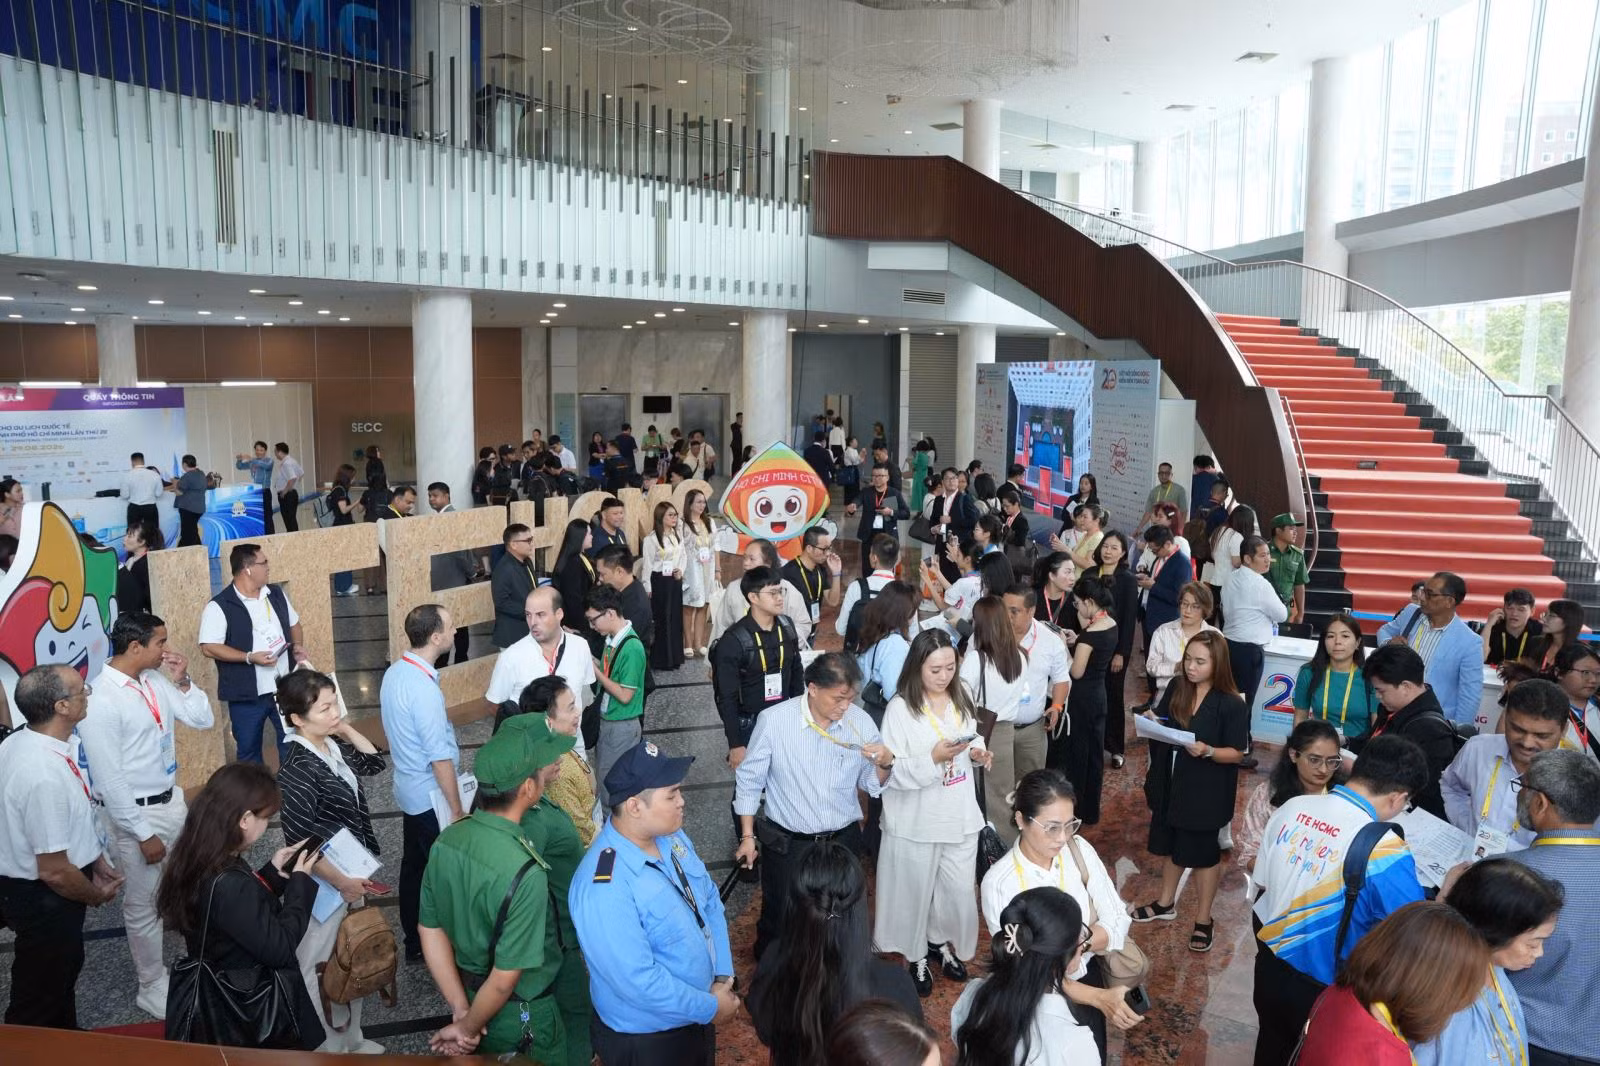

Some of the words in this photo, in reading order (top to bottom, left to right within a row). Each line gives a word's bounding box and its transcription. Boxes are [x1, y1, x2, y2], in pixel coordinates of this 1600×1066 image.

[141, 393, 155, 401] TIN
[351, 422, 383, 433] SECC
[750, 473, 769, 485] CHI
[772, 471, 798, 481] MINH
[1296, 813, 1312, 826] ITE
[1312, 819, 1341, 838] HCMC
